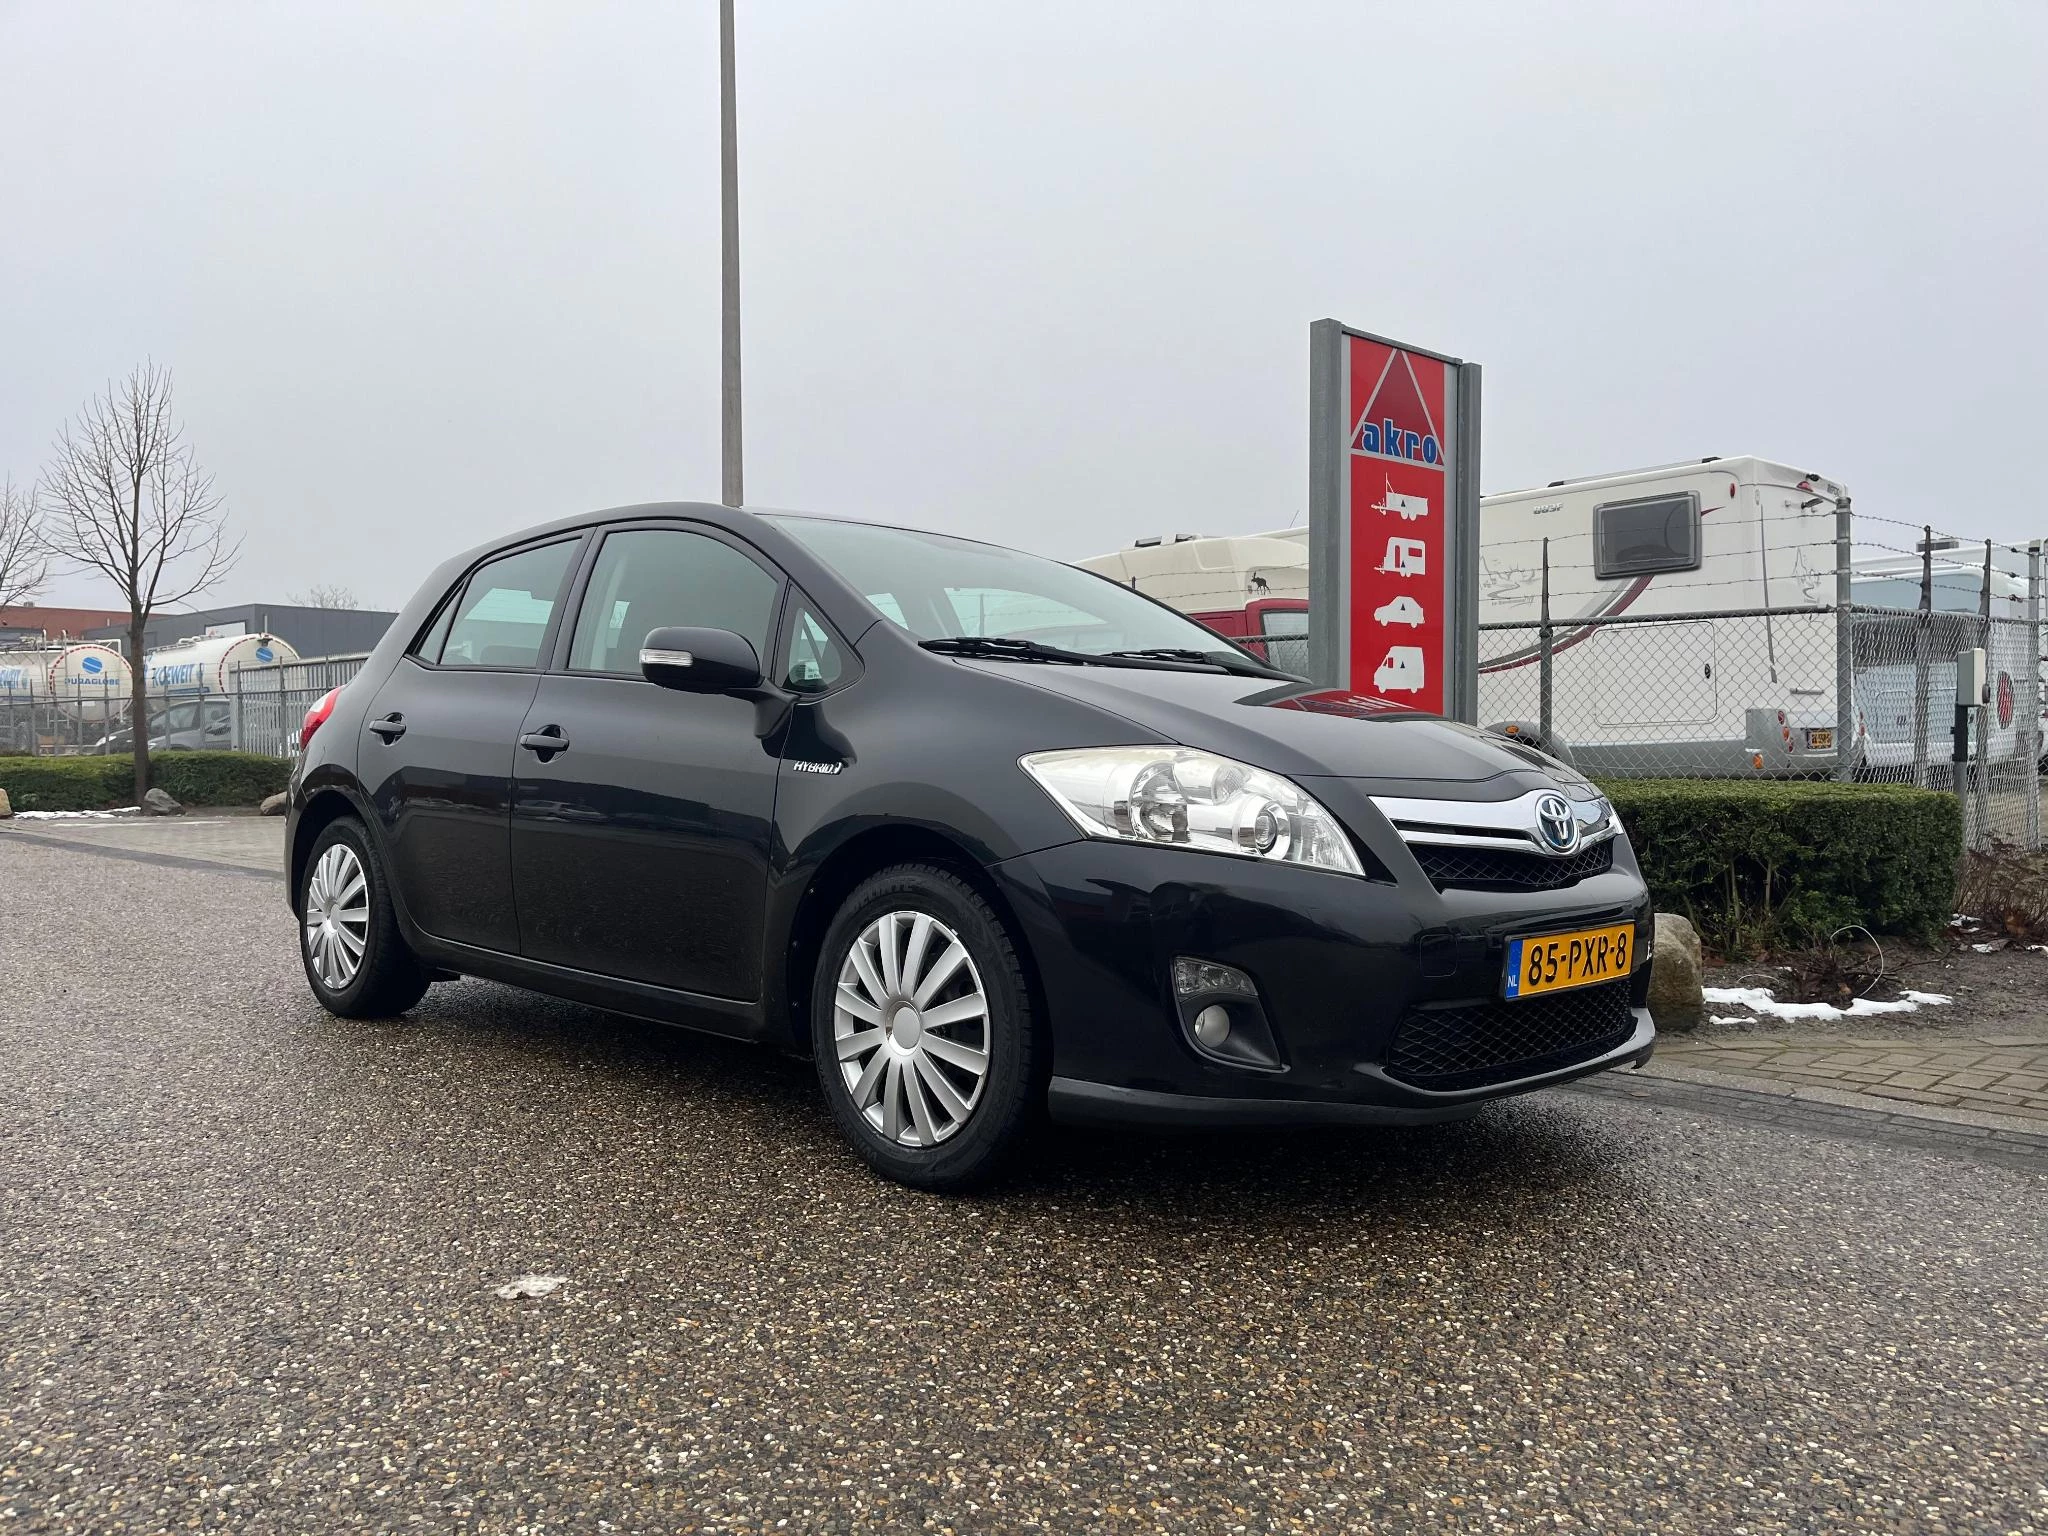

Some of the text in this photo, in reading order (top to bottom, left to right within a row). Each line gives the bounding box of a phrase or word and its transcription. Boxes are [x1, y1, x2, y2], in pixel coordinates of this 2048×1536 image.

[1362, 418, 1438, 464] akro
[793, 760, 833, 774] HYBRID
[1528, 932, 1627, 987] 85-PXR-8
[1507, 975, 1518, 988] NL
